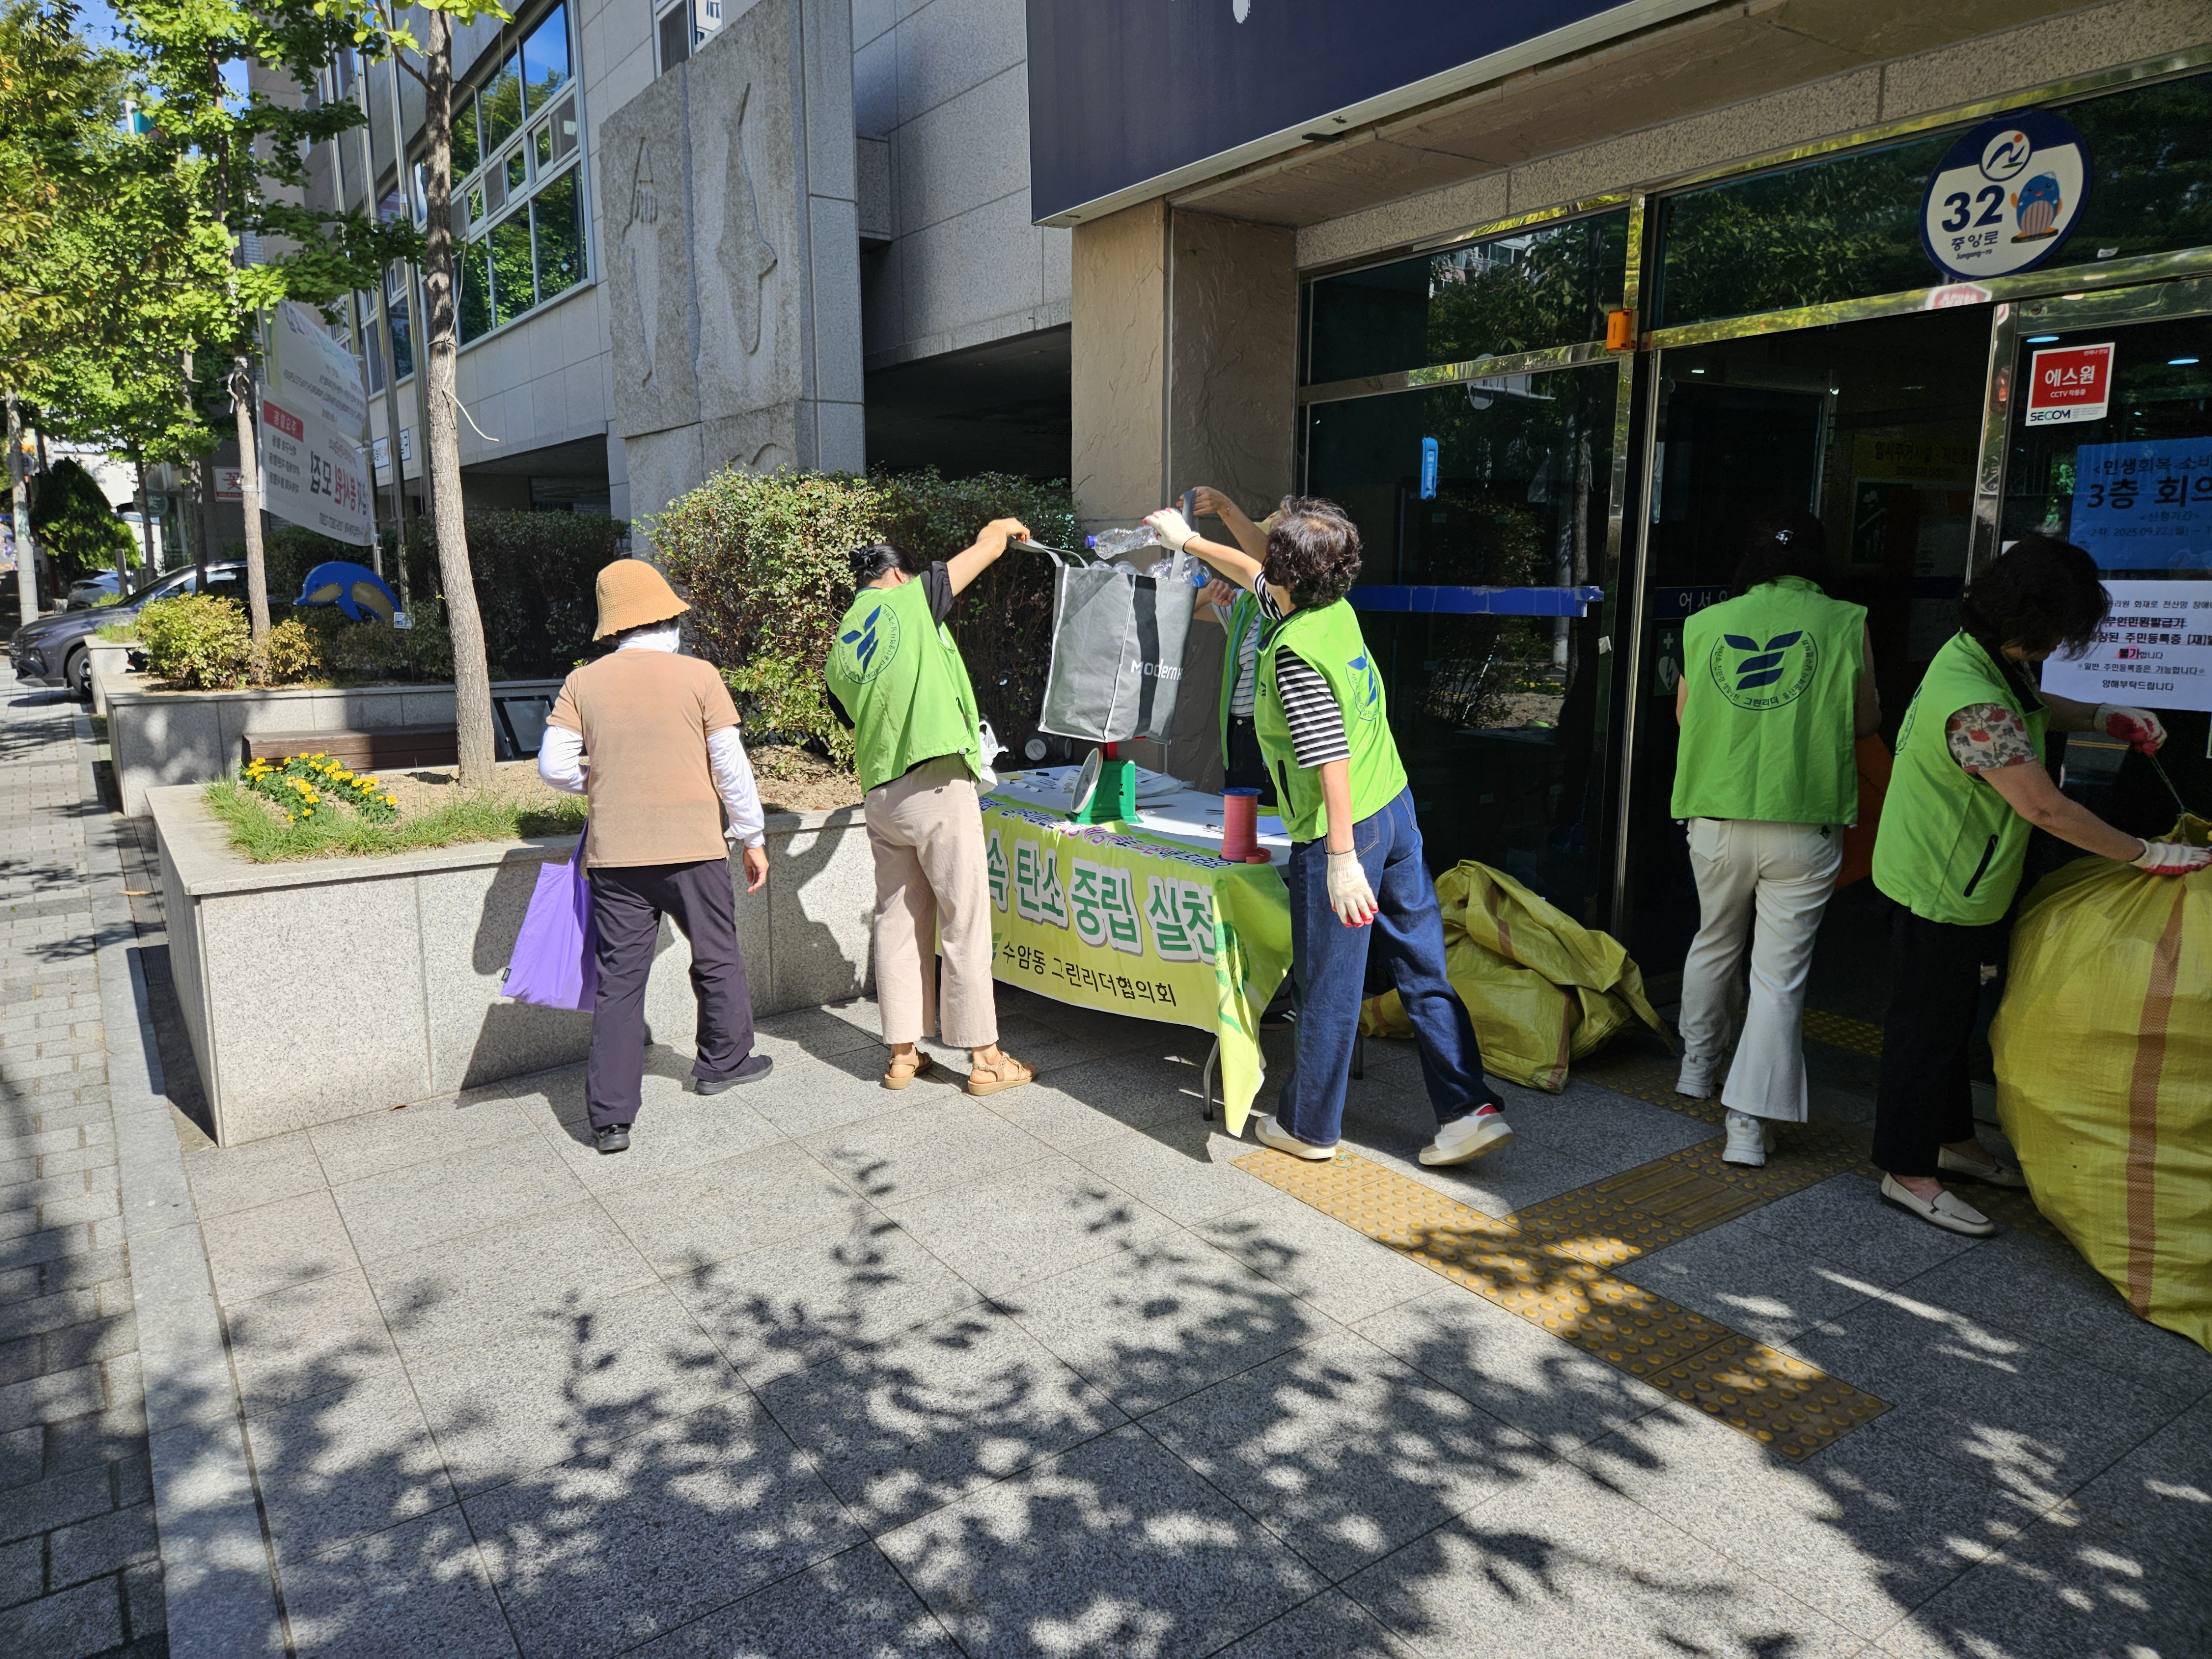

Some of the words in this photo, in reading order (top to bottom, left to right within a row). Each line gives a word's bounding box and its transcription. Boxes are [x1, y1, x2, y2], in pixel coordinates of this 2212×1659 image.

[1942, 185, 2005, 232] 32
[1951, 231, 1999, 251] 중앙로
[1956, 249, 1992, 260] Jungang-ro
[2045, 366, 2095, 387] 에스원
[2030, 409, 2070, 421] SECOM
[2087, 478, 2139, 509] 3층
[2163, 601, 2188, 609] 전산망
[2088, 632, 2119, 643] 장된
[2125, 633, 2181, 644] 주민등록증
[2119, 648, 2163, 660] 불가합니다
[2104, 664, 2151, 673] 주민등록증은
[2103, 679, 2174, 691] 양해부탁드립니다
[1018, 848, 1065, 919] 탄소
[1071, 867, 1138, 943] 중립
[1003, 941, 1046, 975] 수암동
[1052, 957, 1177, 1007] 그린리더협의회
